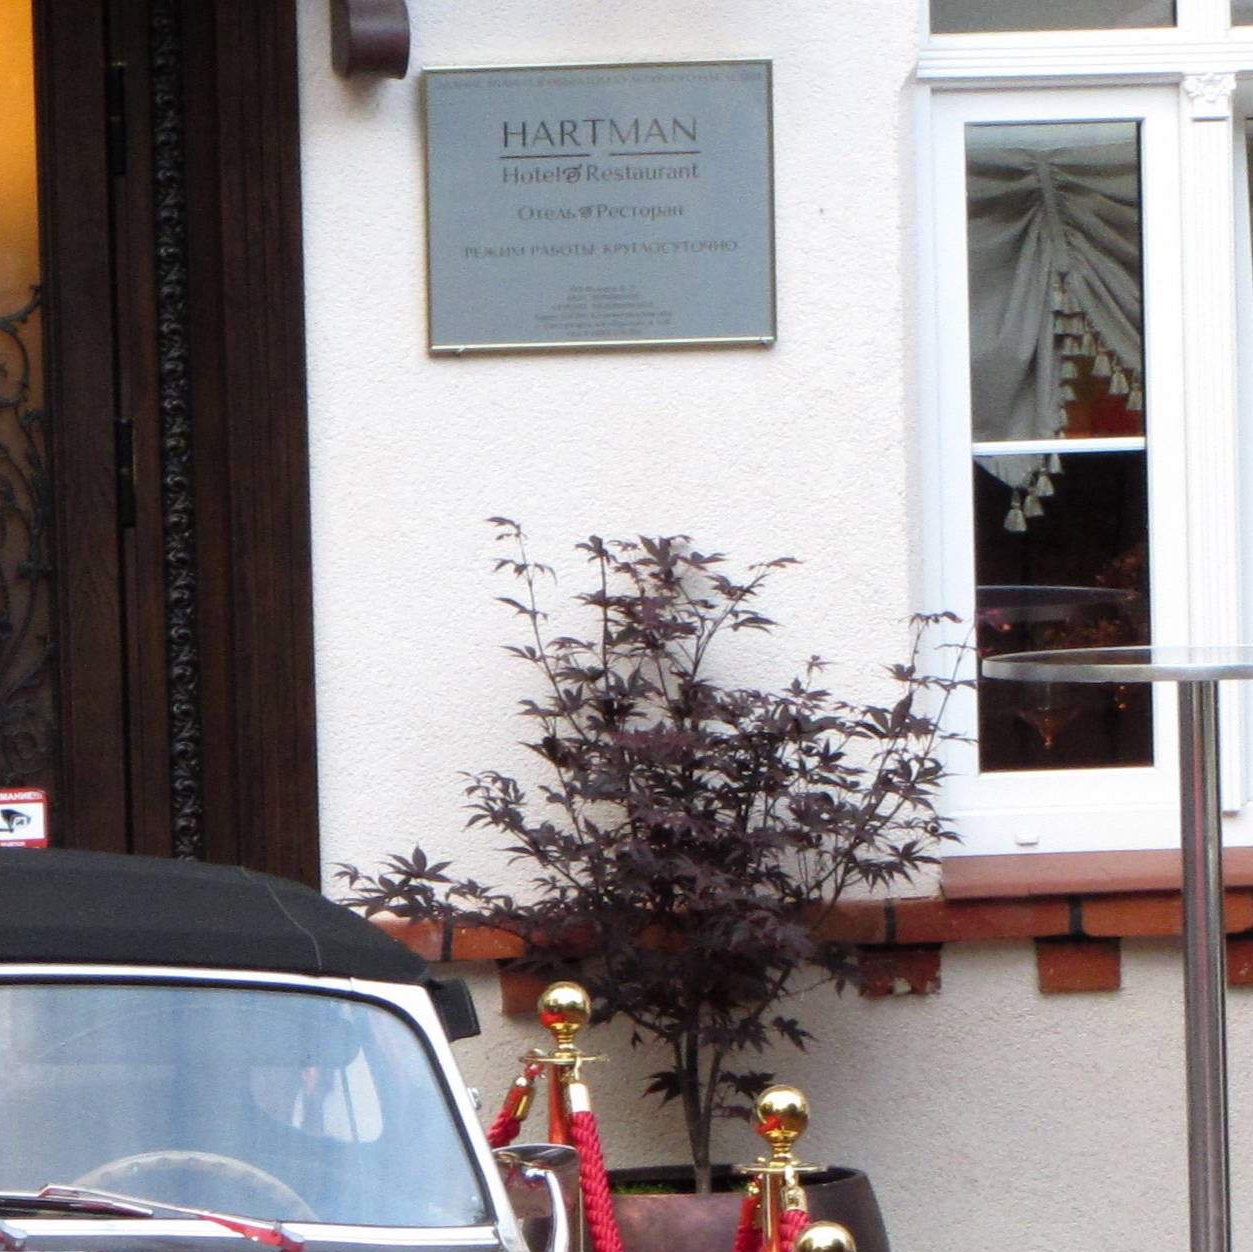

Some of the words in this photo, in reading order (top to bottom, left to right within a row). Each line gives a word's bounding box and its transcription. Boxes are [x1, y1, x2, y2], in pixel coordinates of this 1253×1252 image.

[503, 117, 698, 148] HARTMAN
[502, 165, 560, 185] Hotel
[586, 162, 700, 182] Restaurant
[517, 205, 575, 221] Отель
[596, 203, 685, 221] Ресторан
